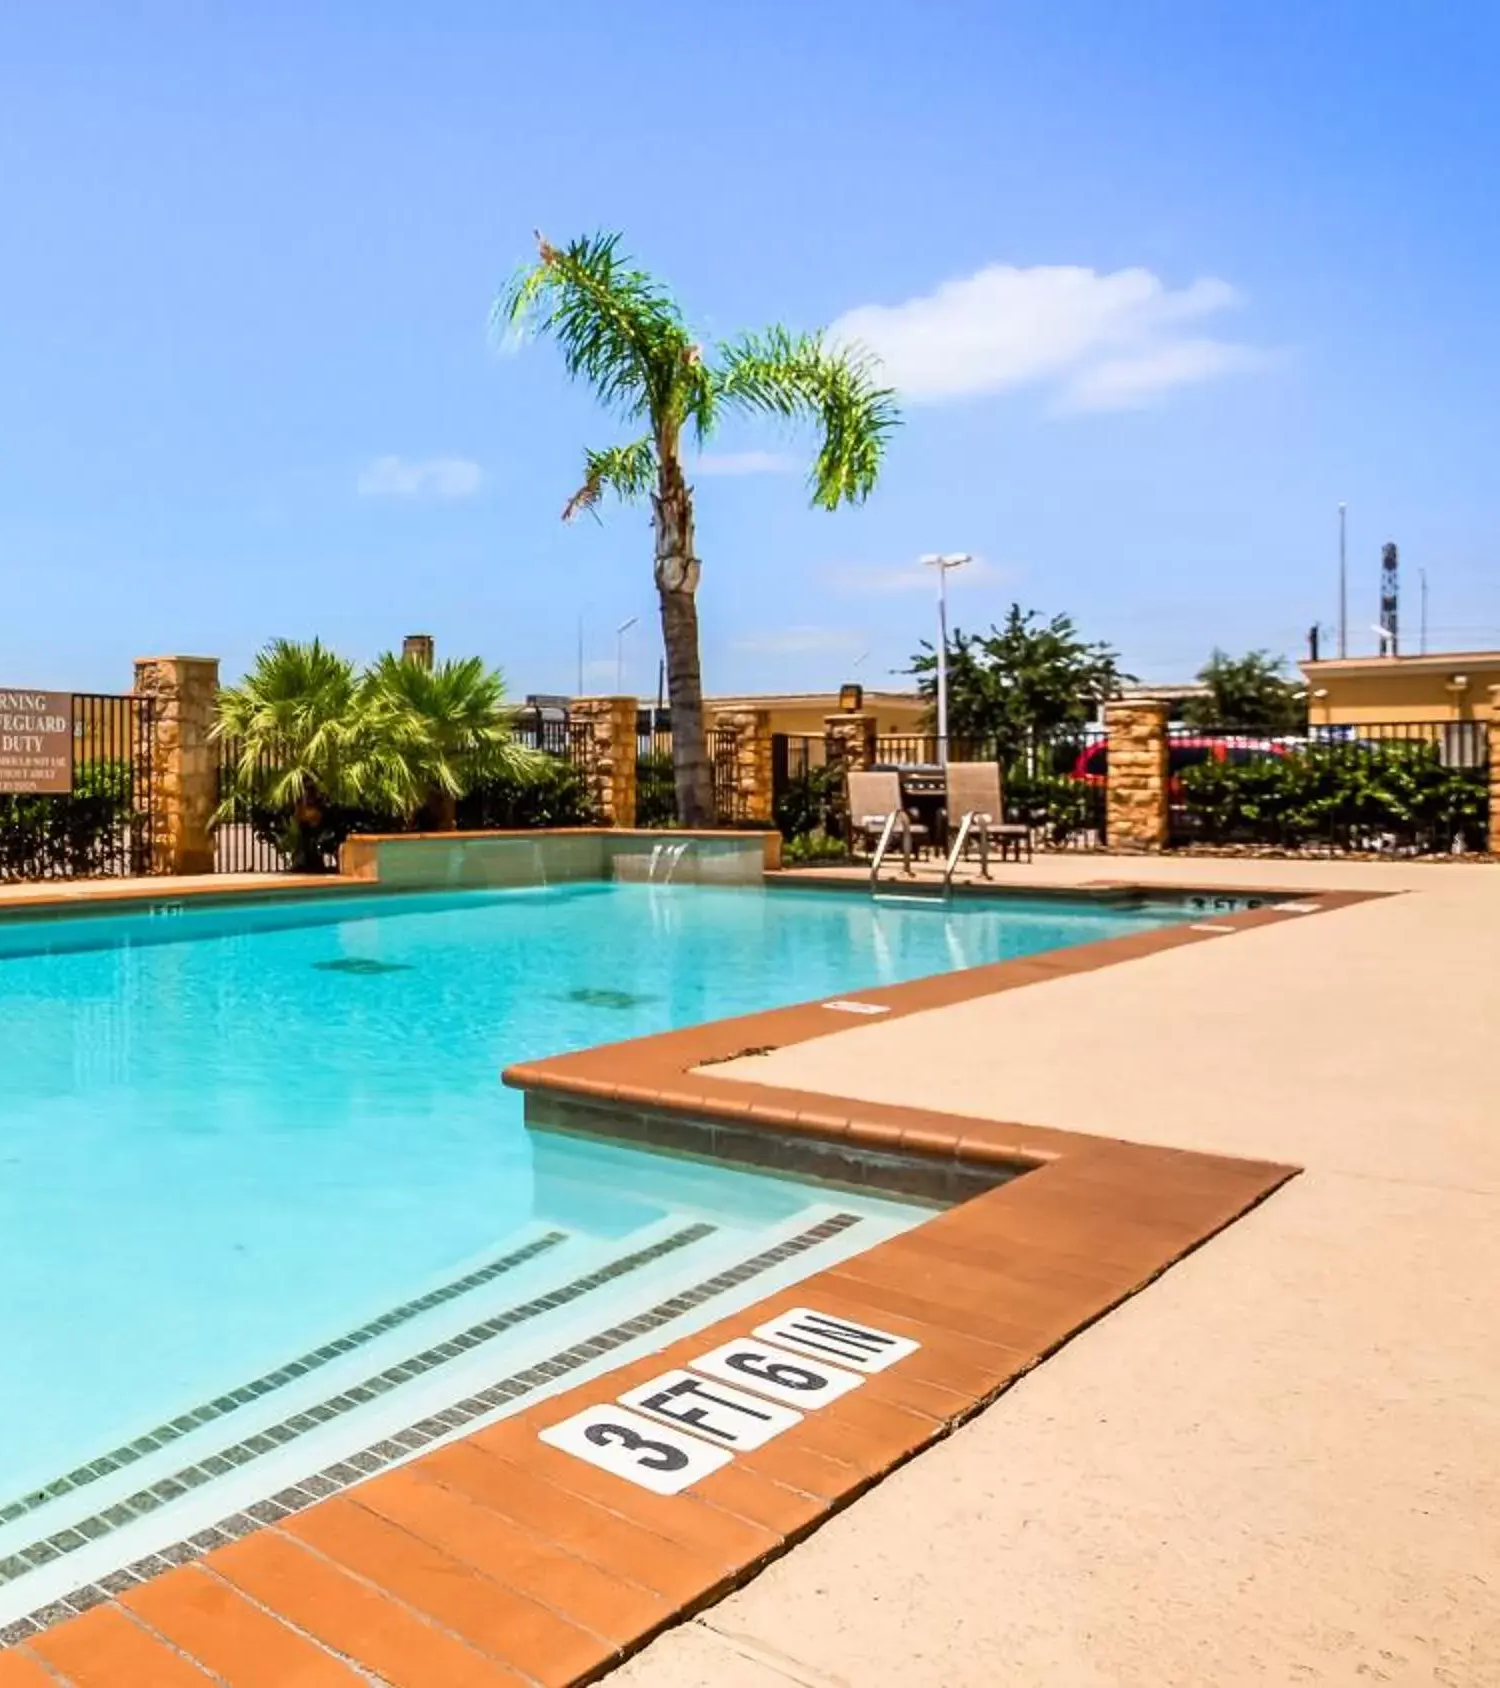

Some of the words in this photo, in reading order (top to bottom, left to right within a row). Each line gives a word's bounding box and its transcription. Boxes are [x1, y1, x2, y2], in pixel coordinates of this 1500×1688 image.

[3, 735, 44, 753] DUTY
[775, 1315, 897, 1363] IN
[725, 1352, 829, 1391] 6
[639, 1379, 773, 1441] FT
[584, 1423, 690, 1472] 3
